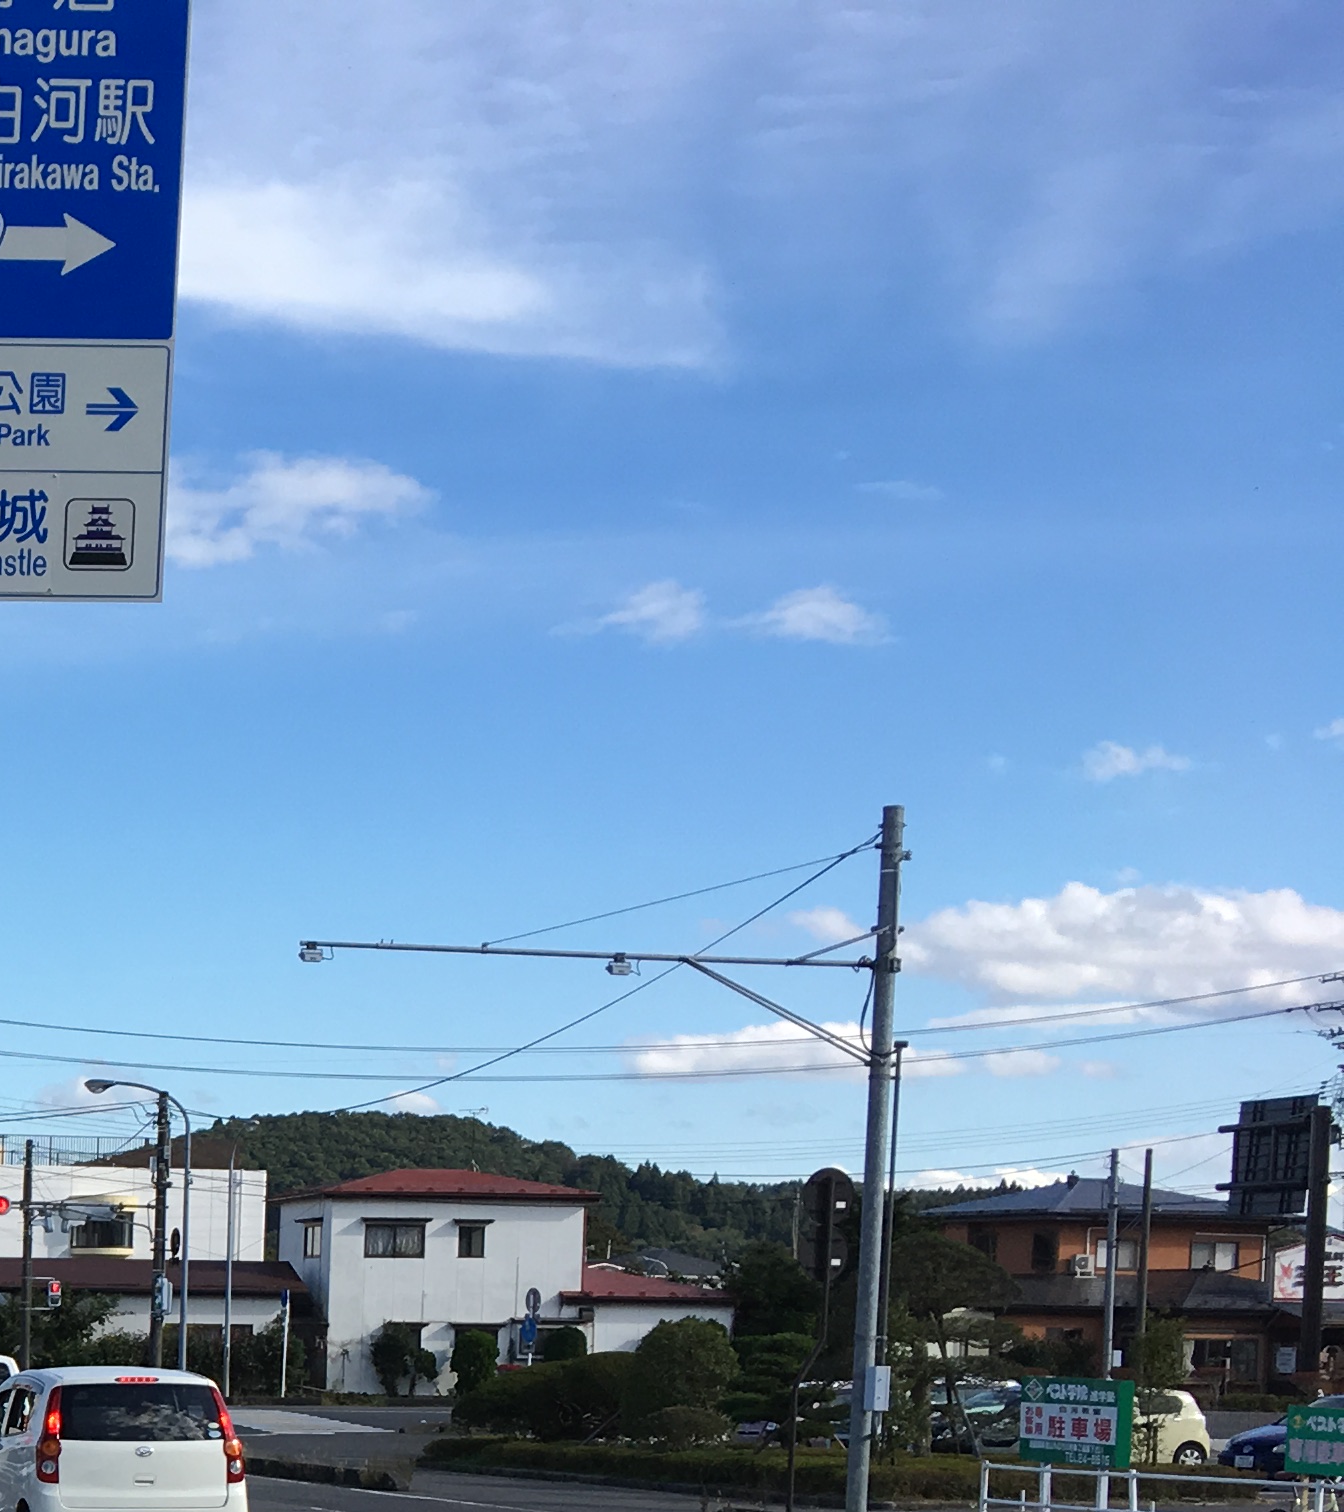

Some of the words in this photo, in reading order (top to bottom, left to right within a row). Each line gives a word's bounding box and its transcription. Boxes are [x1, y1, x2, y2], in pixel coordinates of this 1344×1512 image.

[110, 155, 160, 193] Sta.
[1047, 1415, 1112, 1443] 駐車場
